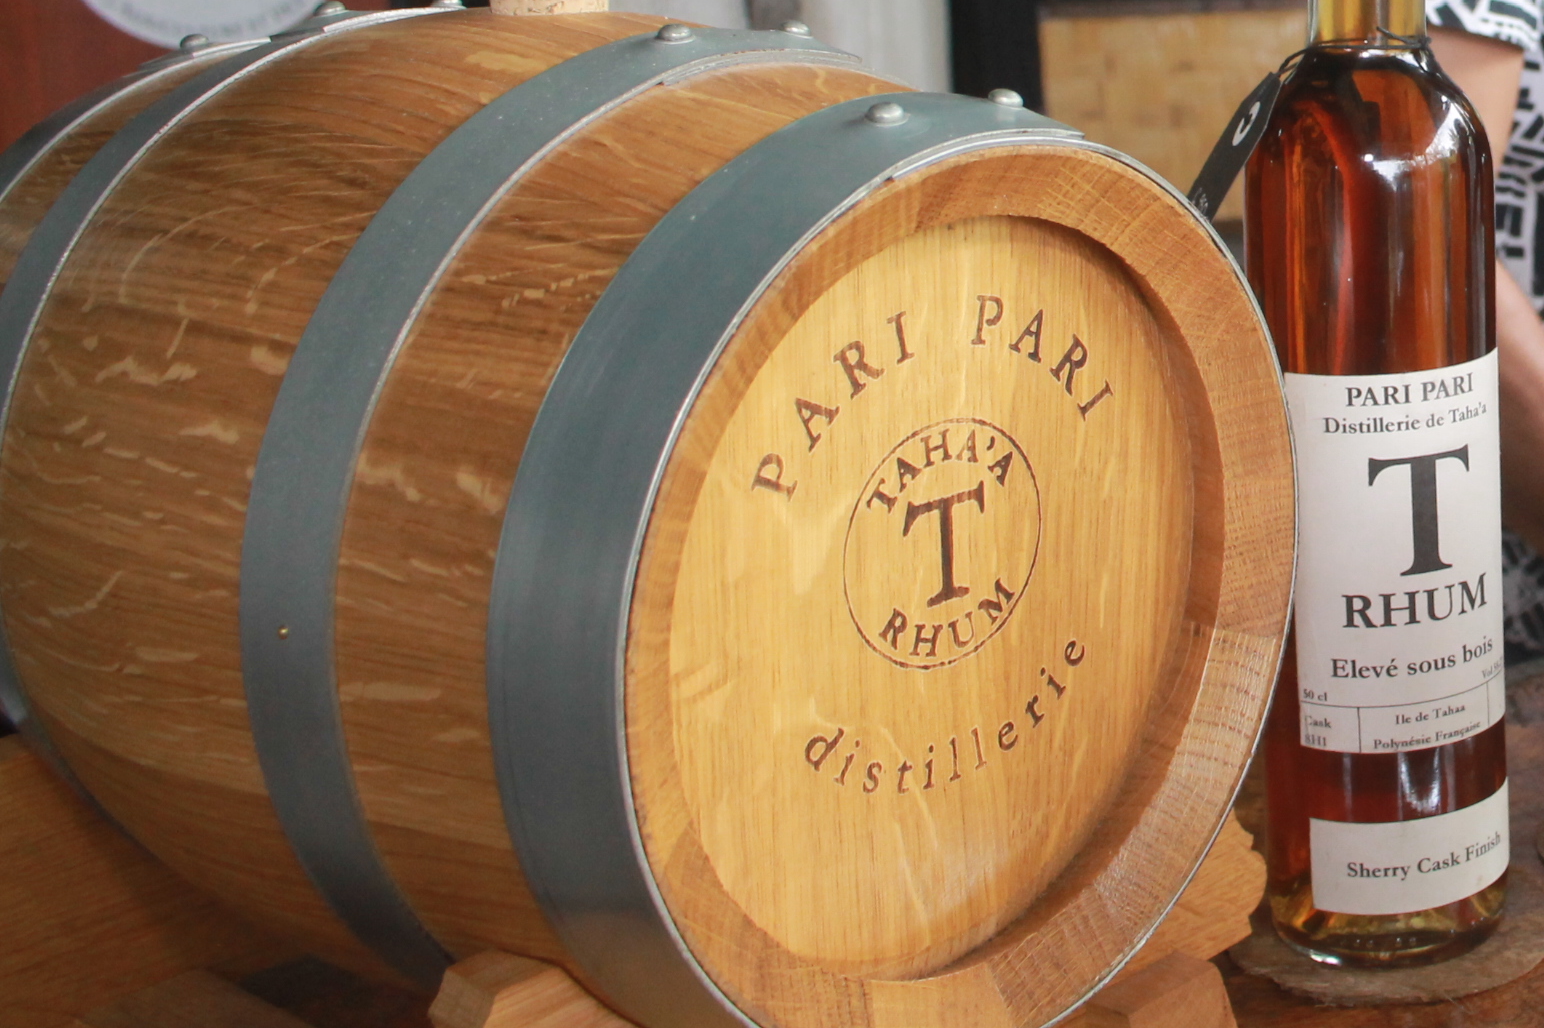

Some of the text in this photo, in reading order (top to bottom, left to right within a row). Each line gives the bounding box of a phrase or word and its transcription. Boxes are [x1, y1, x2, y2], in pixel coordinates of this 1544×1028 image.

[751, 295, 1114, 502] PARI PARI
[1323, 402, 1487, 434] Distillerie de Taha'a
[1345, 372, 1474, 407] PARI PARI
[866, 428, 1014, 515] TAHA'A
[1368, 443, 1470, 577] T
[902, 480, 985, 609] T
[878, 579, 1015, 658] RHUM
[1341, 572, 1488, 629] RHUM
[1330, 657, 1399, 680] Elevé
[1406, 654, 1456, 676] sous
[1462, 636, 1493, 663] bois
[803, 639, 1086, 795] distillerie
[1373, 736, 1432, 751] Polynésie
[1415, 711, 1430, 722] de
[1347, 831, 1501, 881] Sherry Cask Finish
